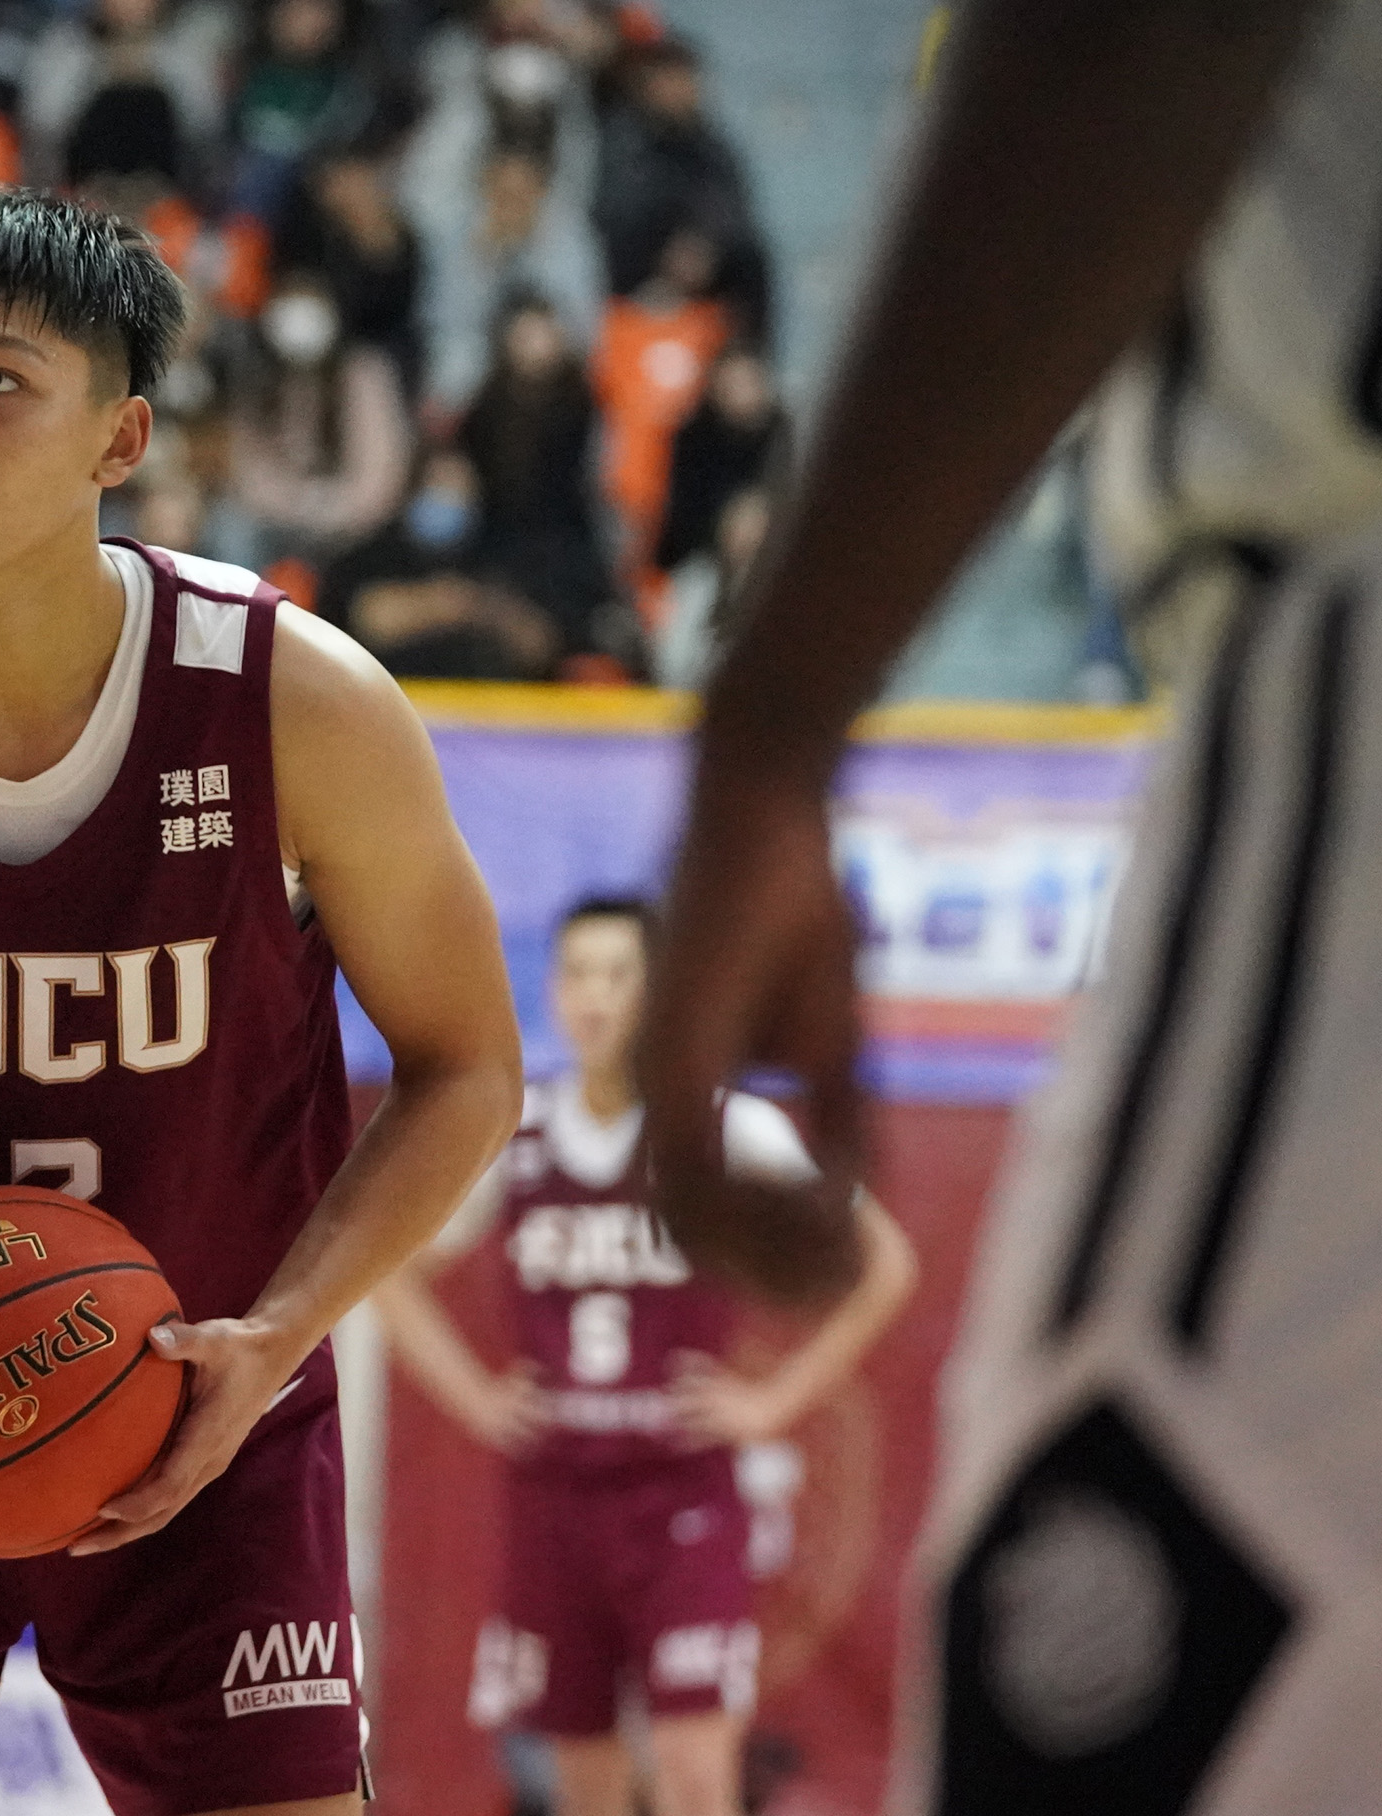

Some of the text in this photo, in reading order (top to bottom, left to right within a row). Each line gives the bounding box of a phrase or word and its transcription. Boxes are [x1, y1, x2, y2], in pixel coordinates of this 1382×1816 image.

[160, 764, 231, 806] 璞園
[161, 809, 235, 855] 建築
[221, 1620, 338, 1689] MW
[232, 1681, 347, 1711] MEAN WELL
